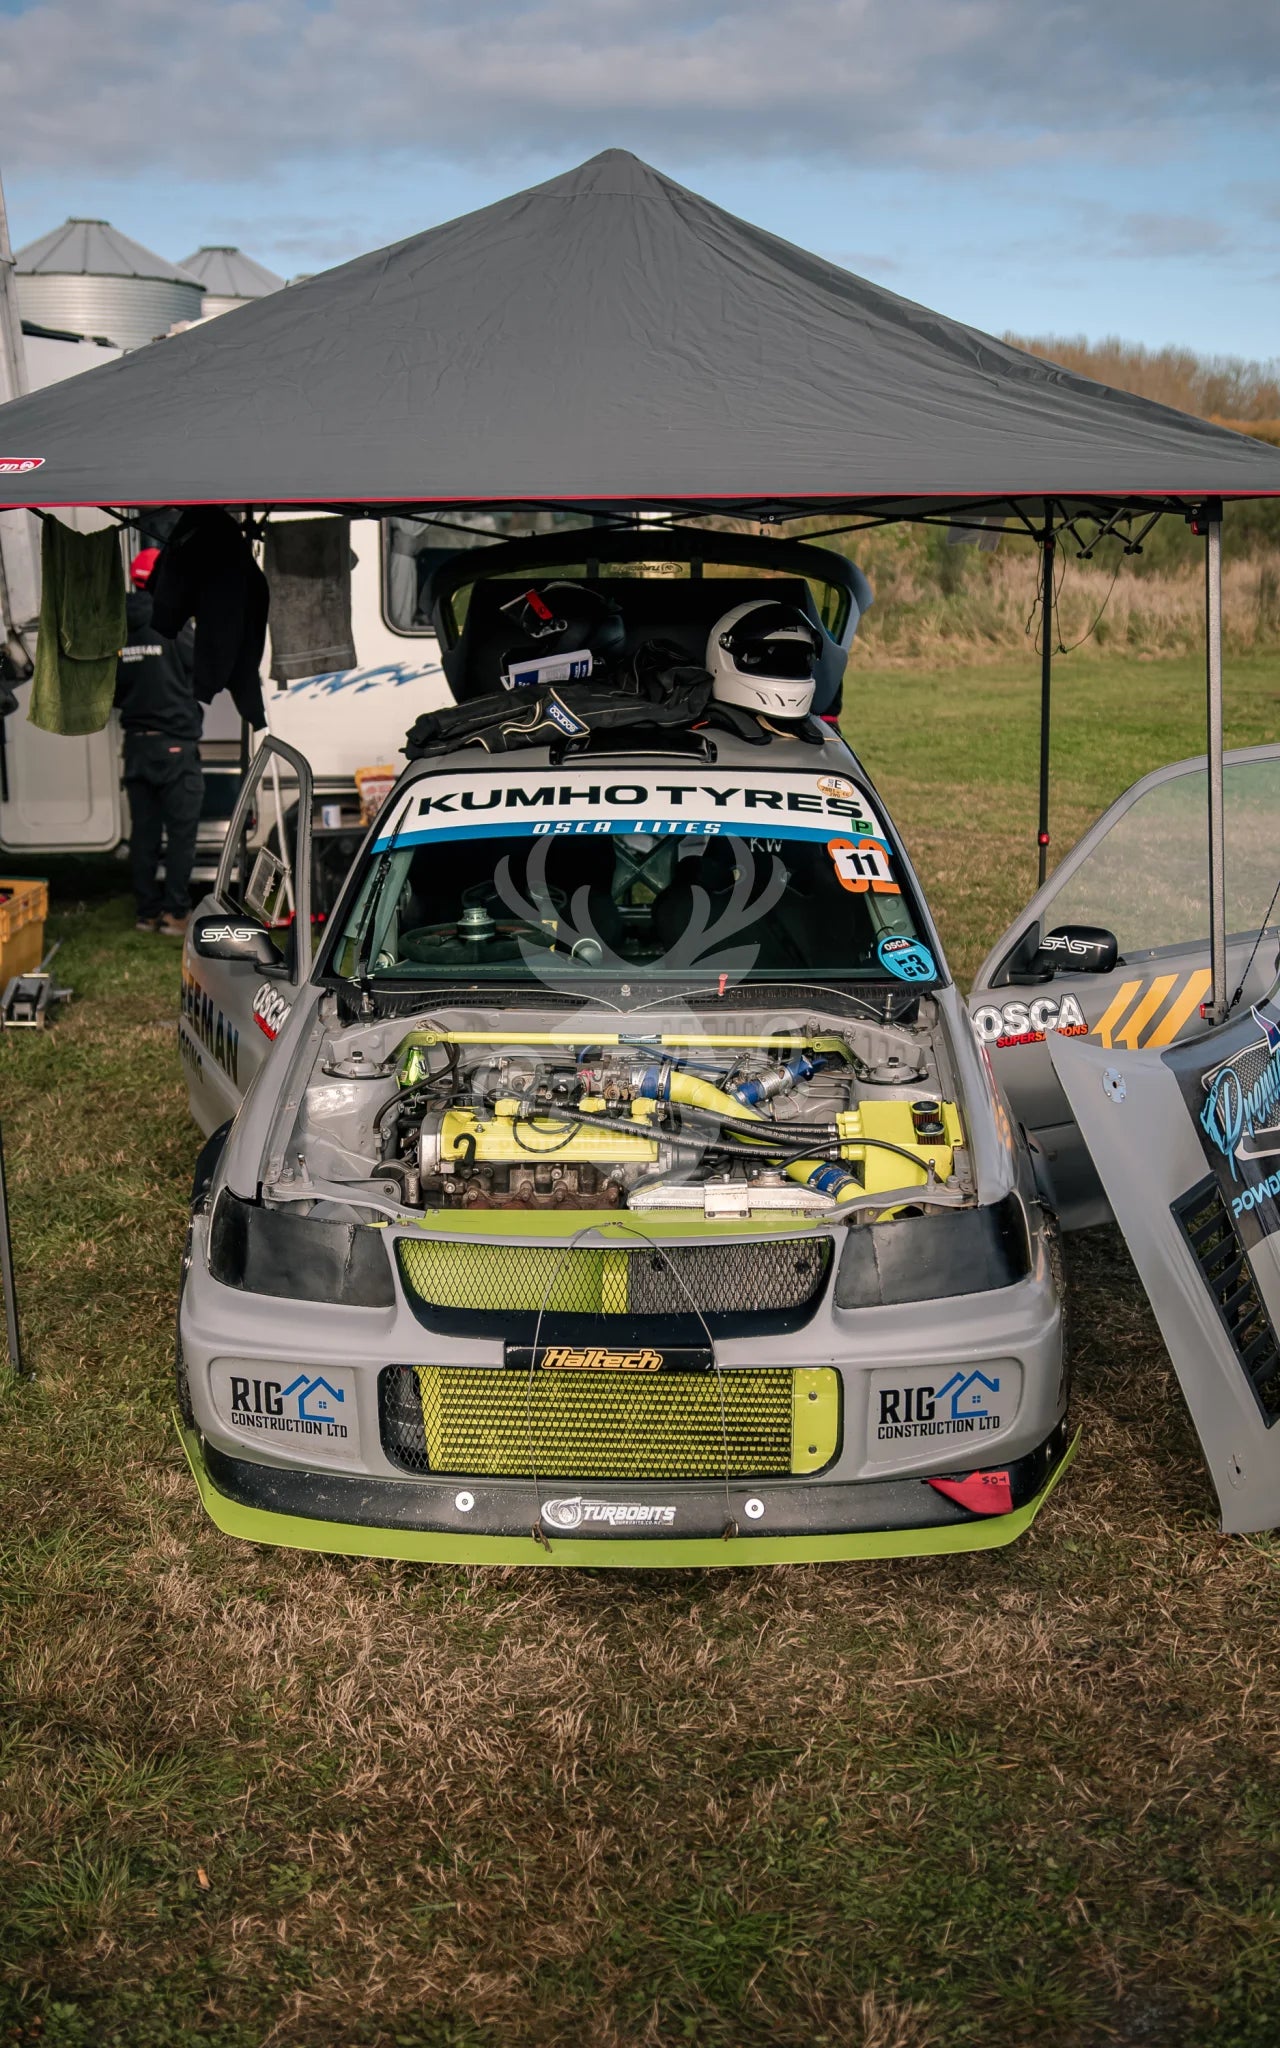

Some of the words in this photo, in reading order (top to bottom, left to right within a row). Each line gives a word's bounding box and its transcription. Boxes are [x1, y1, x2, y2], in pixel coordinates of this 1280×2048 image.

[549, 704, 579, 733] sparco
[417, 785, 649, 816] KUMHO
[656, 785, 863, 819] TYRES
[532, 821, 612, 834] OSCA
[633, 821, 722, 834] LITES
[855, 821, 869, 833] P
[846, 853, 880, 876] 11
[200, 925, 268, 942] SAS
[883, 939, 910, 951] OSCA
[1039, 935, 1109, 955] SAS
[252, 981, 292, 1035] OSCA
[973, 993, 1087, 1043] OSCA
[542, 1347, 663, 1371] Haltech
[230, 1376, 284, 1416] RIG
[878, 1385, 936, 1425] RIG
[231, 1412, 323, 1436] CONSTRUCTION
[327, 1423, 348, 1438] LTD
[877, 1418, 974, 1440] CONSTRUCTION
[979, 1415, 1000, 1430] LTD
[584, 1506, 677, 1526] TURBOBITS
